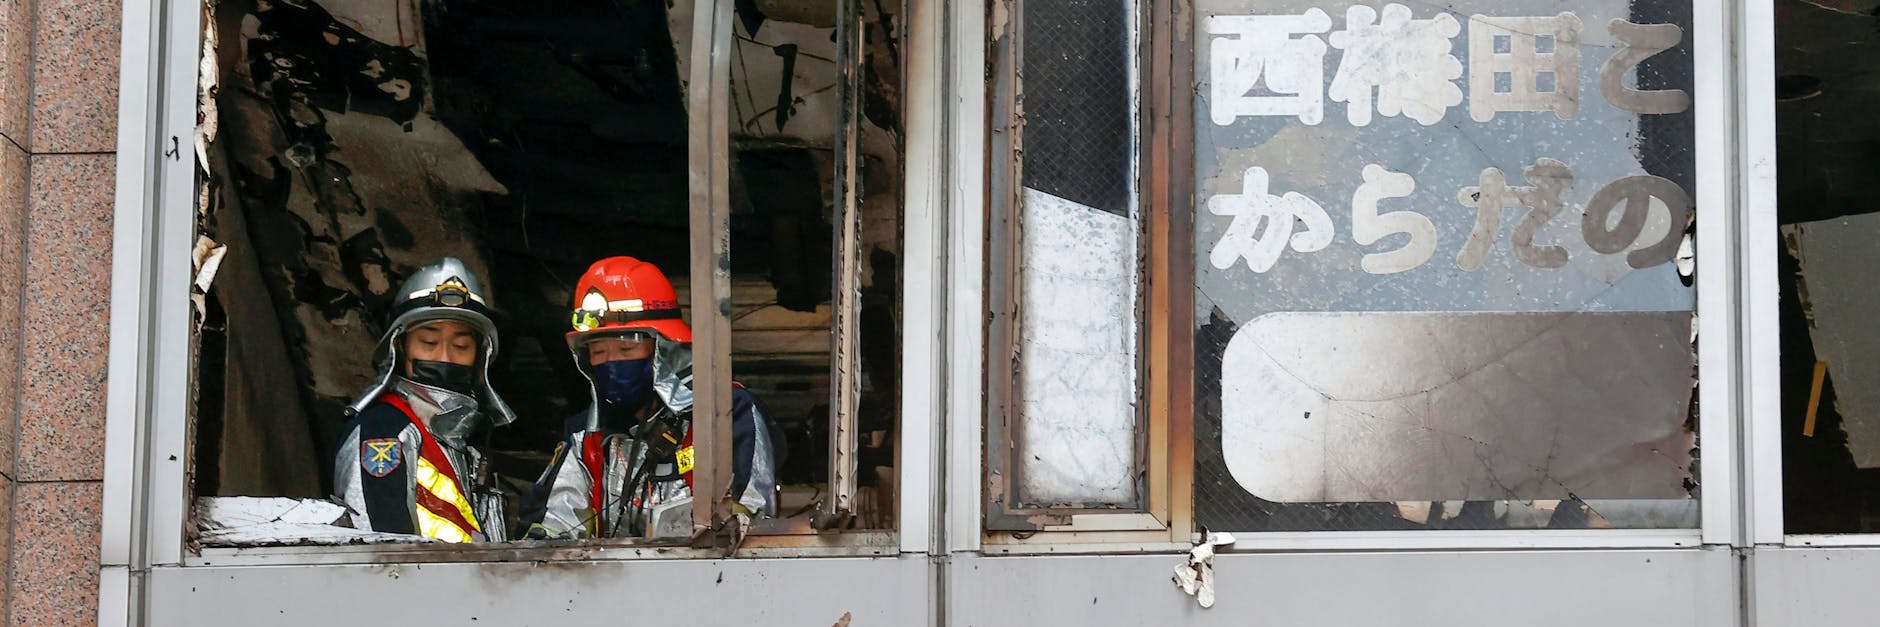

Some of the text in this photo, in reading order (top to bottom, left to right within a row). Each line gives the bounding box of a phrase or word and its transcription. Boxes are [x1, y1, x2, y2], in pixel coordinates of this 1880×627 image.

[1206, 4, 1689, 126] 西梅田こ
[1208, 158, 1688, 273] からだの
